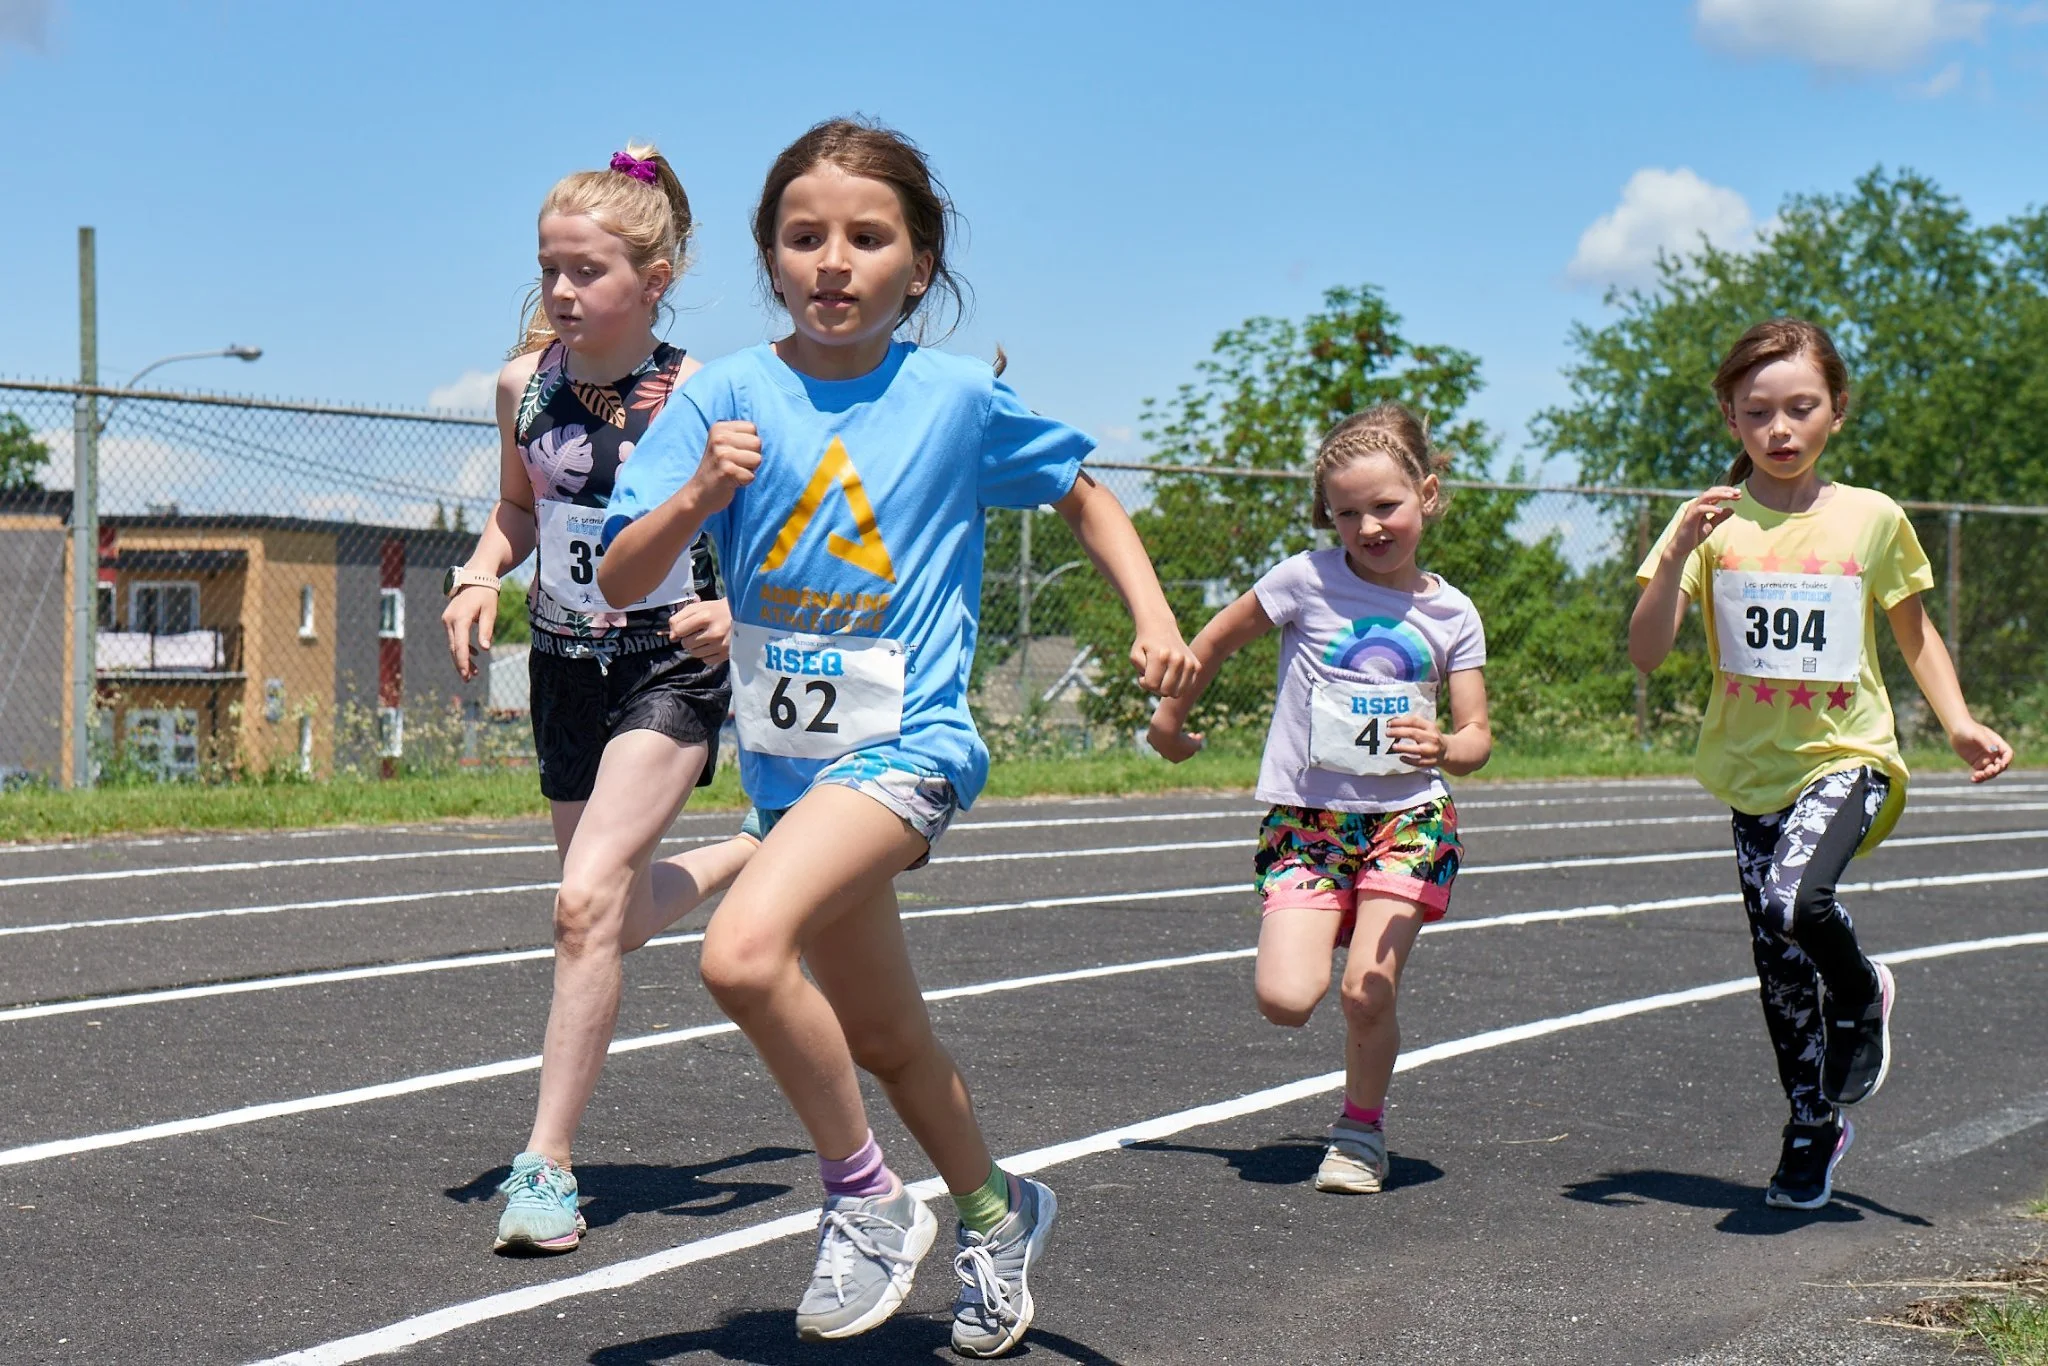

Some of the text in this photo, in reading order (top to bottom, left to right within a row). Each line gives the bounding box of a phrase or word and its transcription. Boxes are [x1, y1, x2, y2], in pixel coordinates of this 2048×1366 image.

[569, 540, 605, 585] 3
[1744, 580, 1757, 589] Les
[623, 634, 670, 655] ARM
[1745, 605, 1827, 652] 394
[765, 643, 845, 677] RSEQ
[769, 676, 839, 734] 62
[1351, 695, 1410, 716] RSEQ
